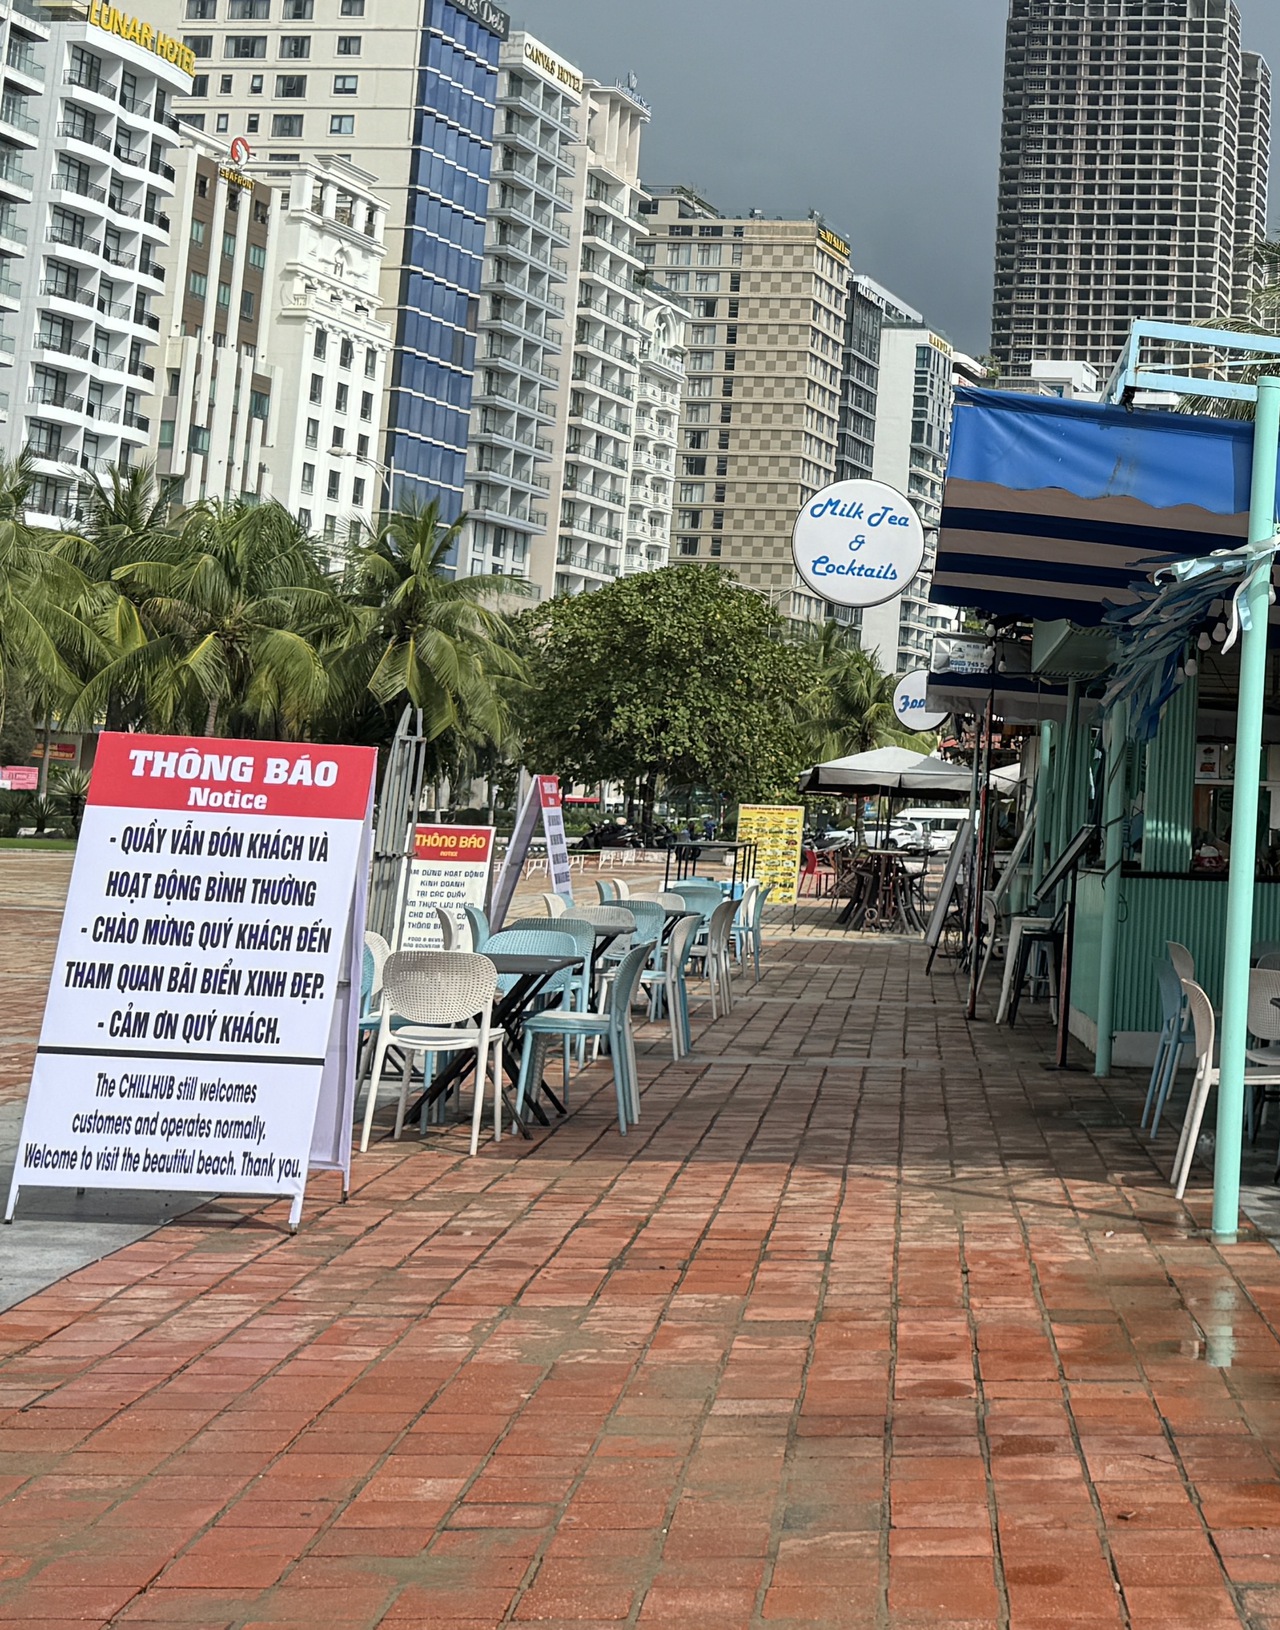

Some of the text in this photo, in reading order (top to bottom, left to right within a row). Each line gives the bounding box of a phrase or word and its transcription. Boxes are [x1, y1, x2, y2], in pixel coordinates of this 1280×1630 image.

[480, 0, 505, 33] Deli
[90, 0, 196, 77] LUNAR HOTEL
[525, 43, 556, 76] CANVAS
[557, 64, 583, 94] HOTEL
[220, 168, 255, 190] SEAFRONT
[810, 498, 909, 528] Milk Tea
[849, 535, 866, 552] &
[812, 556, 898, 581] Cocktails
[899, 695, 925, 713] Foo
[129, 748, 339, 787] THÔNG BÁO
[187, 787, 268, 810] Notice
[121, 819, 167, 854] QUẦY
[171, 820, 205, 856] VẪN
[208, 826, 244, 857] ĐÓN
[247, 829, 305, 861] KHÁCH
[308, 831, 329, 862] VÀ
[415, 833, 486, 848] THÔNG BÁO
[106, 870, 317, 907] HOẠT ĐỘNG BÌNH THƯỜNG
[92, 912, 139, 944] CHÀO
[142, 915, 195, 947] MỪNG
[200, 918, 233, 950] QUÝ
[236, 919, 293, 951] KHÁCH
[296, 918, 332, 953] ĐẾN
[65, 958, 325, 1004] THAM QUAN BÃI BIỂN XINH ĐẸP.
[109, 1002, 150, 1038] CẢM
[154, 1010, 179, 1040] ƠN
[182, 1010, 217, 1043] QUÝ
[219, 1011, 281, 1044] KHÁCH.
[96, 1073, 257, 1103] The CHILLHUB still welcomes
[72, 1109, 266, 1145] customers and operates normally.
[23, 1143, 302, 1183] Welcome to visit the beautiful beach. Thank you.
